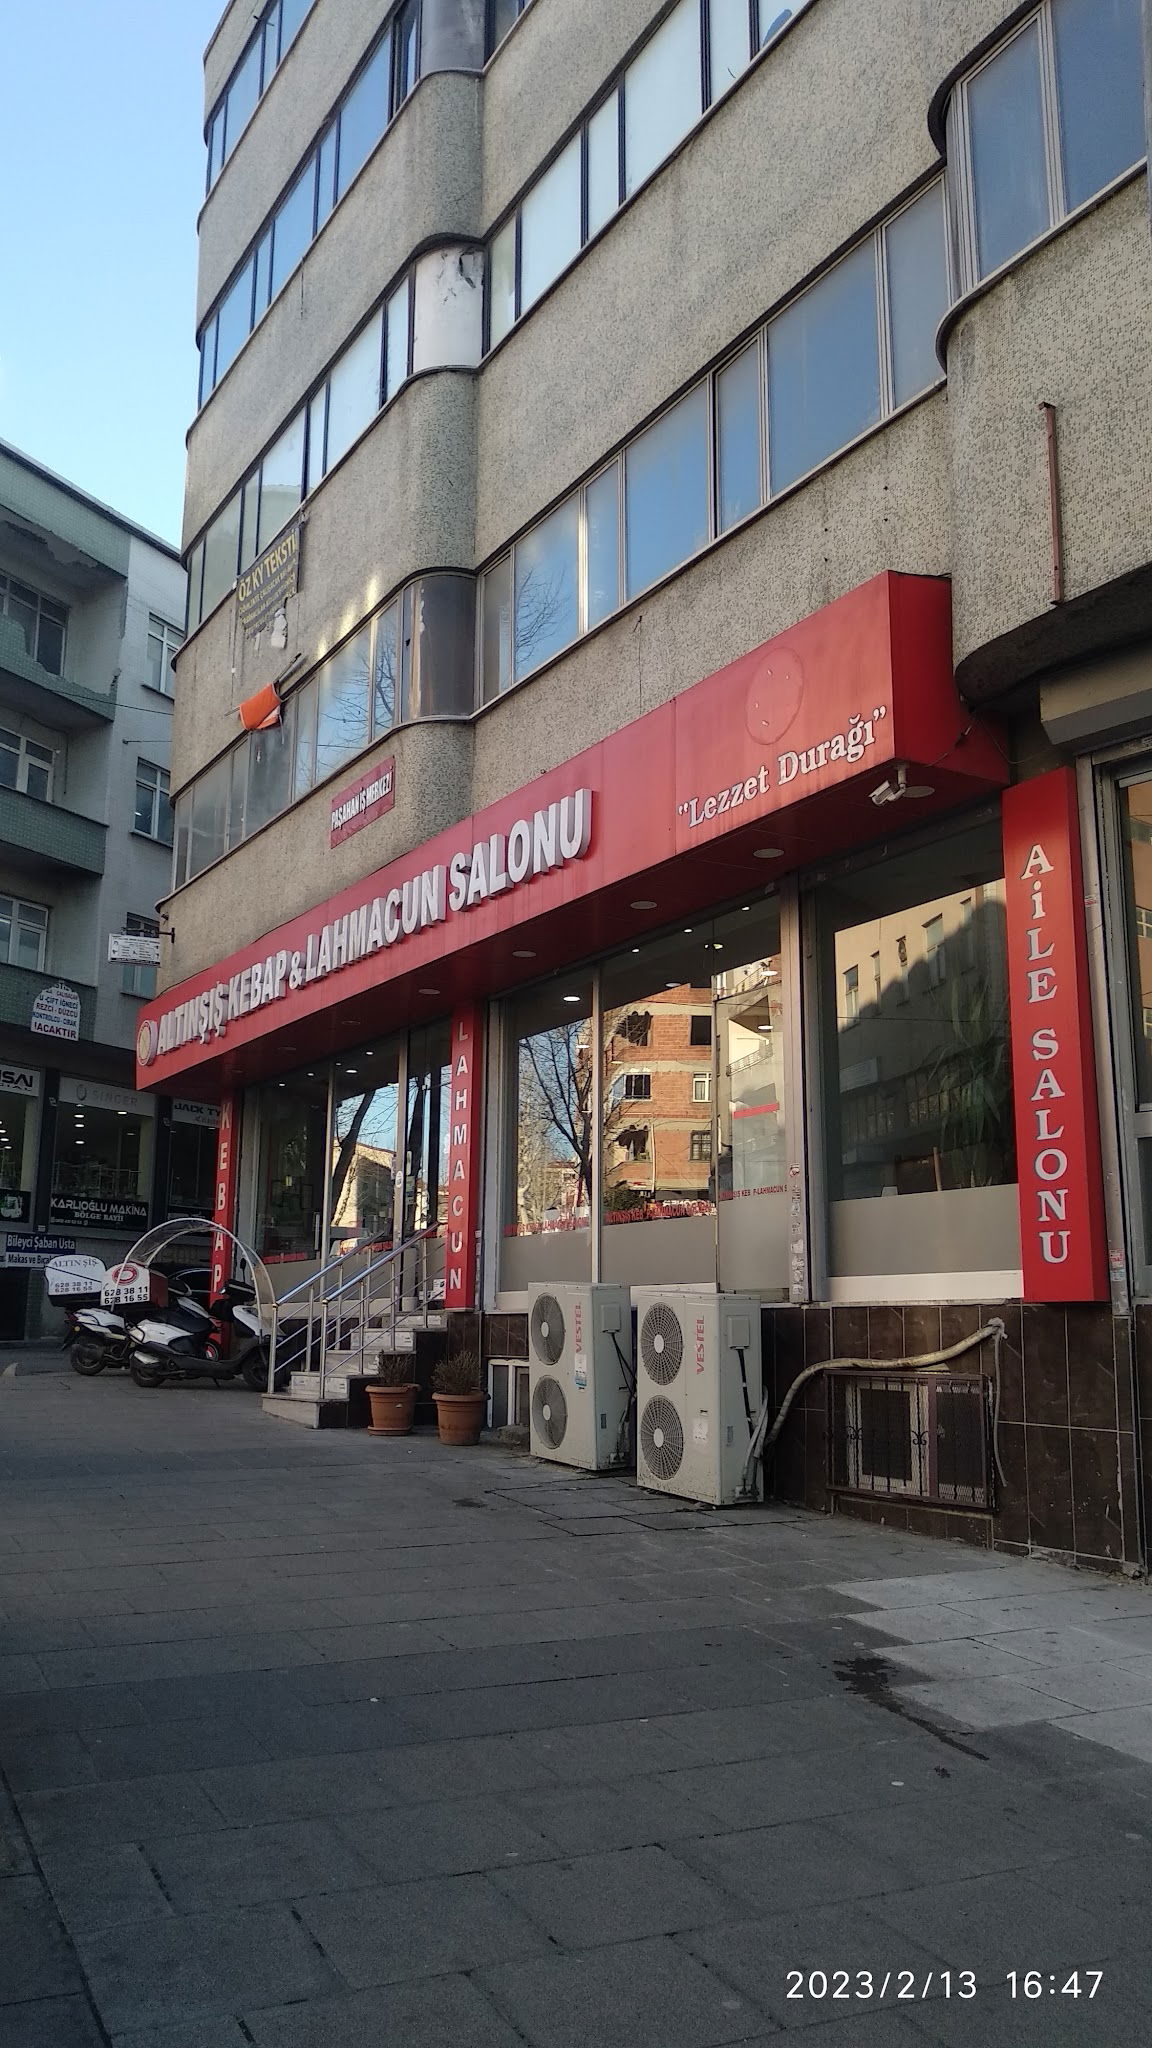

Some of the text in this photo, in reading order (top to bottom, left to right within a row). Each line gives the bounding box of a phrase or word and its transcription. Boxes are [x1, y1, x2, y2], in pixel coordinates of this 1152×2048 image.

[238, 577, 252, 602] ÖZ
[227, 948, 289, 1020] KEBAP
[289, 950, 306, 990] &
[305, 865, 448, 982] LAHMACUN
[449, 788, 594, 912] SALONU
[174, 1102, 204, 1114] JACK
[447, 1020, 471, 1290] LAHMACUN
[1030, 1029, 1071, 1264] SALONU
[50, 1197, 147, 1217] KARLIOĞLU MAKİNA
[211, 1102, 232, 1294] KEBAP
[74, 1210, 102, 1220] BÖLGE
[7, 1234, 75, 1251] Bileyci Şaban Usta
[8, 1253, 28, 1264] Makas
[29, 1256, 36, 1264] ve
[52, 1257, 98, 1268] ALTIN ŞİŞ
[104, 1288, 121, 1297] 628
[123, 1287, 135, 1295] 38
[104, 1296, 121, 1304] 628
[575, 1302, 583, 1353] VESTEL
[696, 1315, 705, 1375] VESTEL
